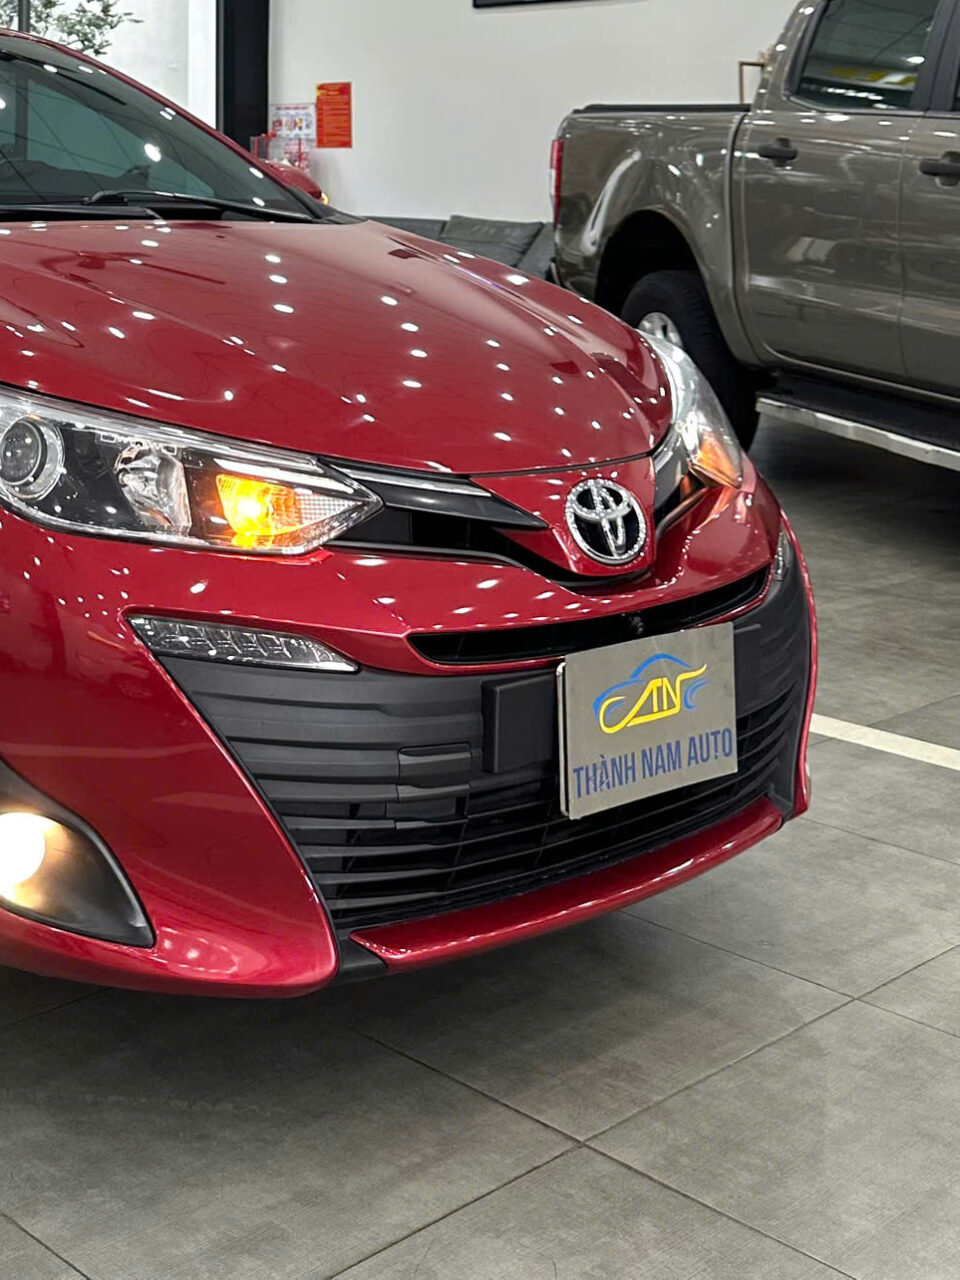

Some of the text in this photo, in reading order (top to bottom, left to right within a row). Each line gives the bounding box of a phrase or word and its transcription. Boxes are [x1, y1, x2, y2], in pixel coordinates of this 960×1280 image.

[573, 728, 733, 798] THÀNH NAM AUTO
